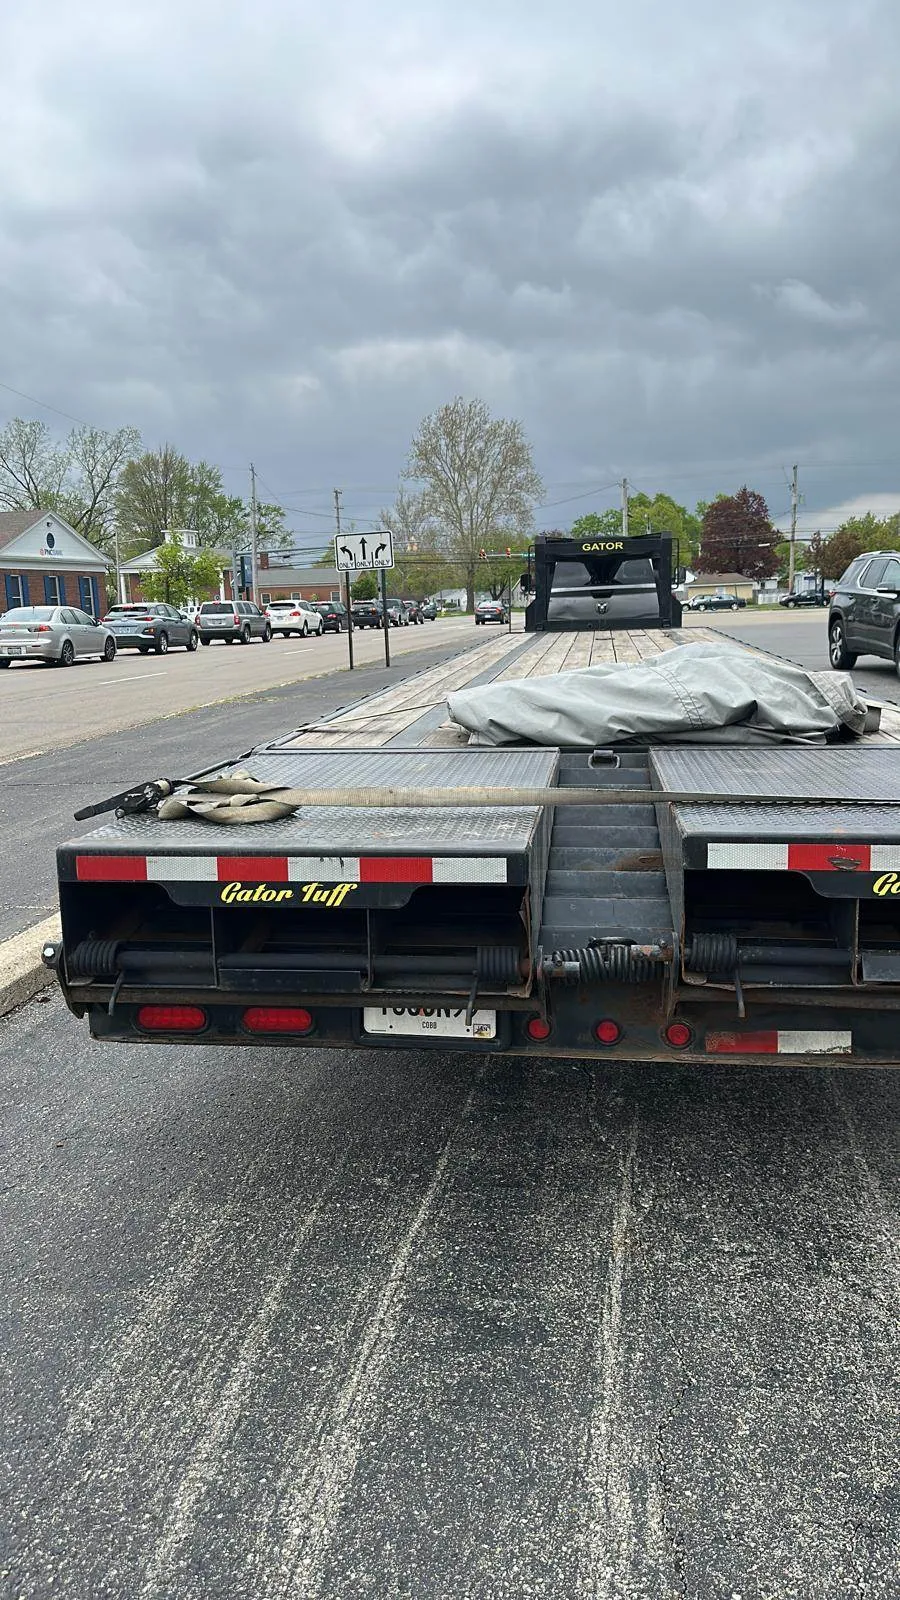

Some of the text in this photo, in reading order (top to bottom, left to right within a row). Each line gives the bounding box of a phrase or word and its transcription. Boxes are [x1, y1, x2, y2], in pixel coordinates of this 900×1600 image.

[582, 541, 624, 551] GATOR
[339, 559, 390, 569] ONLY ONLY ONLY
[220, 881, 358, 907] Gator Tuff
